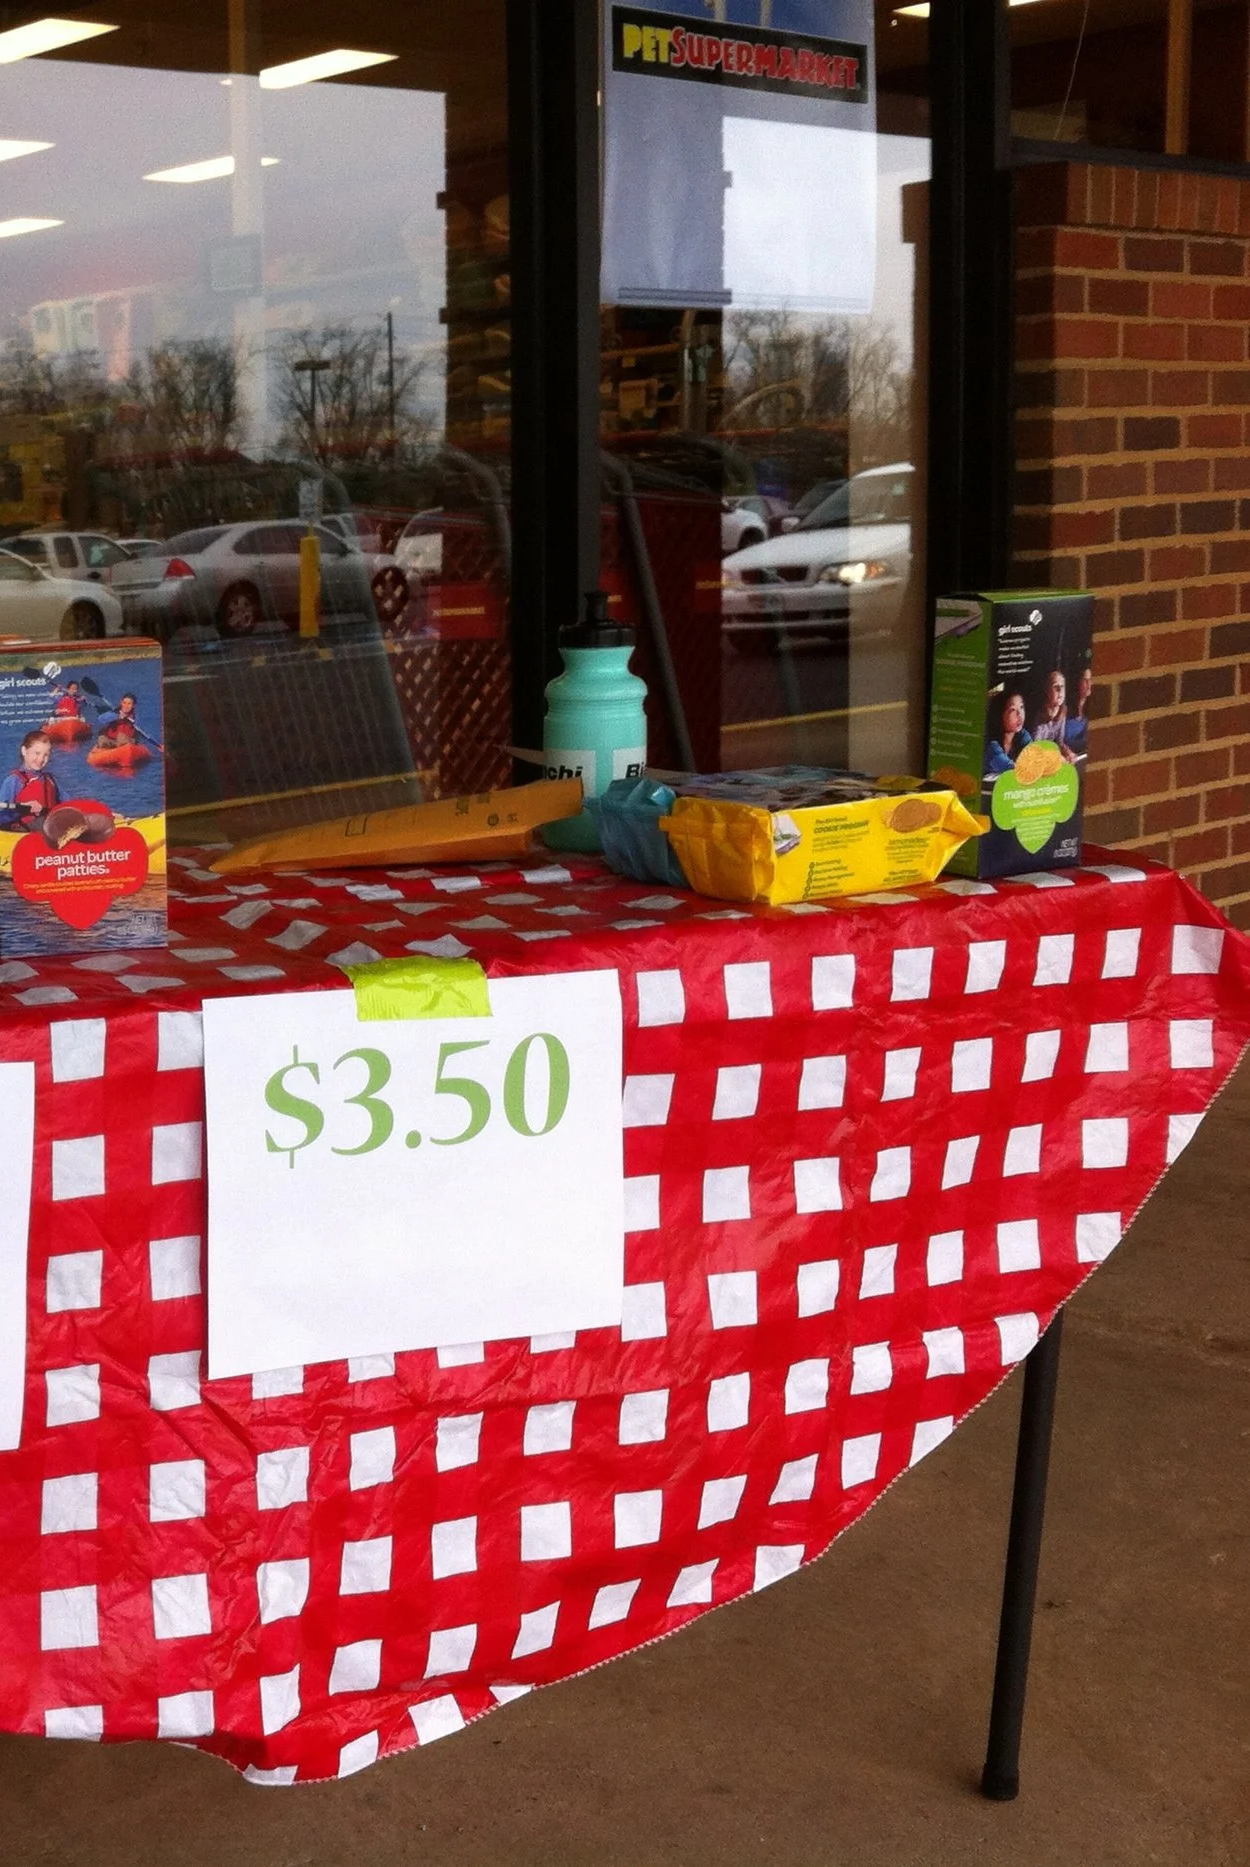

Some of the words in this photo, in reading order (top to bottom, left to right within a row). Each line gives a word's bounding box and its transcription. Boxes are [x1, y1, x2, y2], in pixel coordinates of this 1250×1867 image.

[997, 625, 1011, 636] girl
[16, 677, 47, 687] scouts
[35, 853, 87, 870] peanut
[87, 849, 132, 864] butter
[264, 1032, 571, 1169] $3.50
